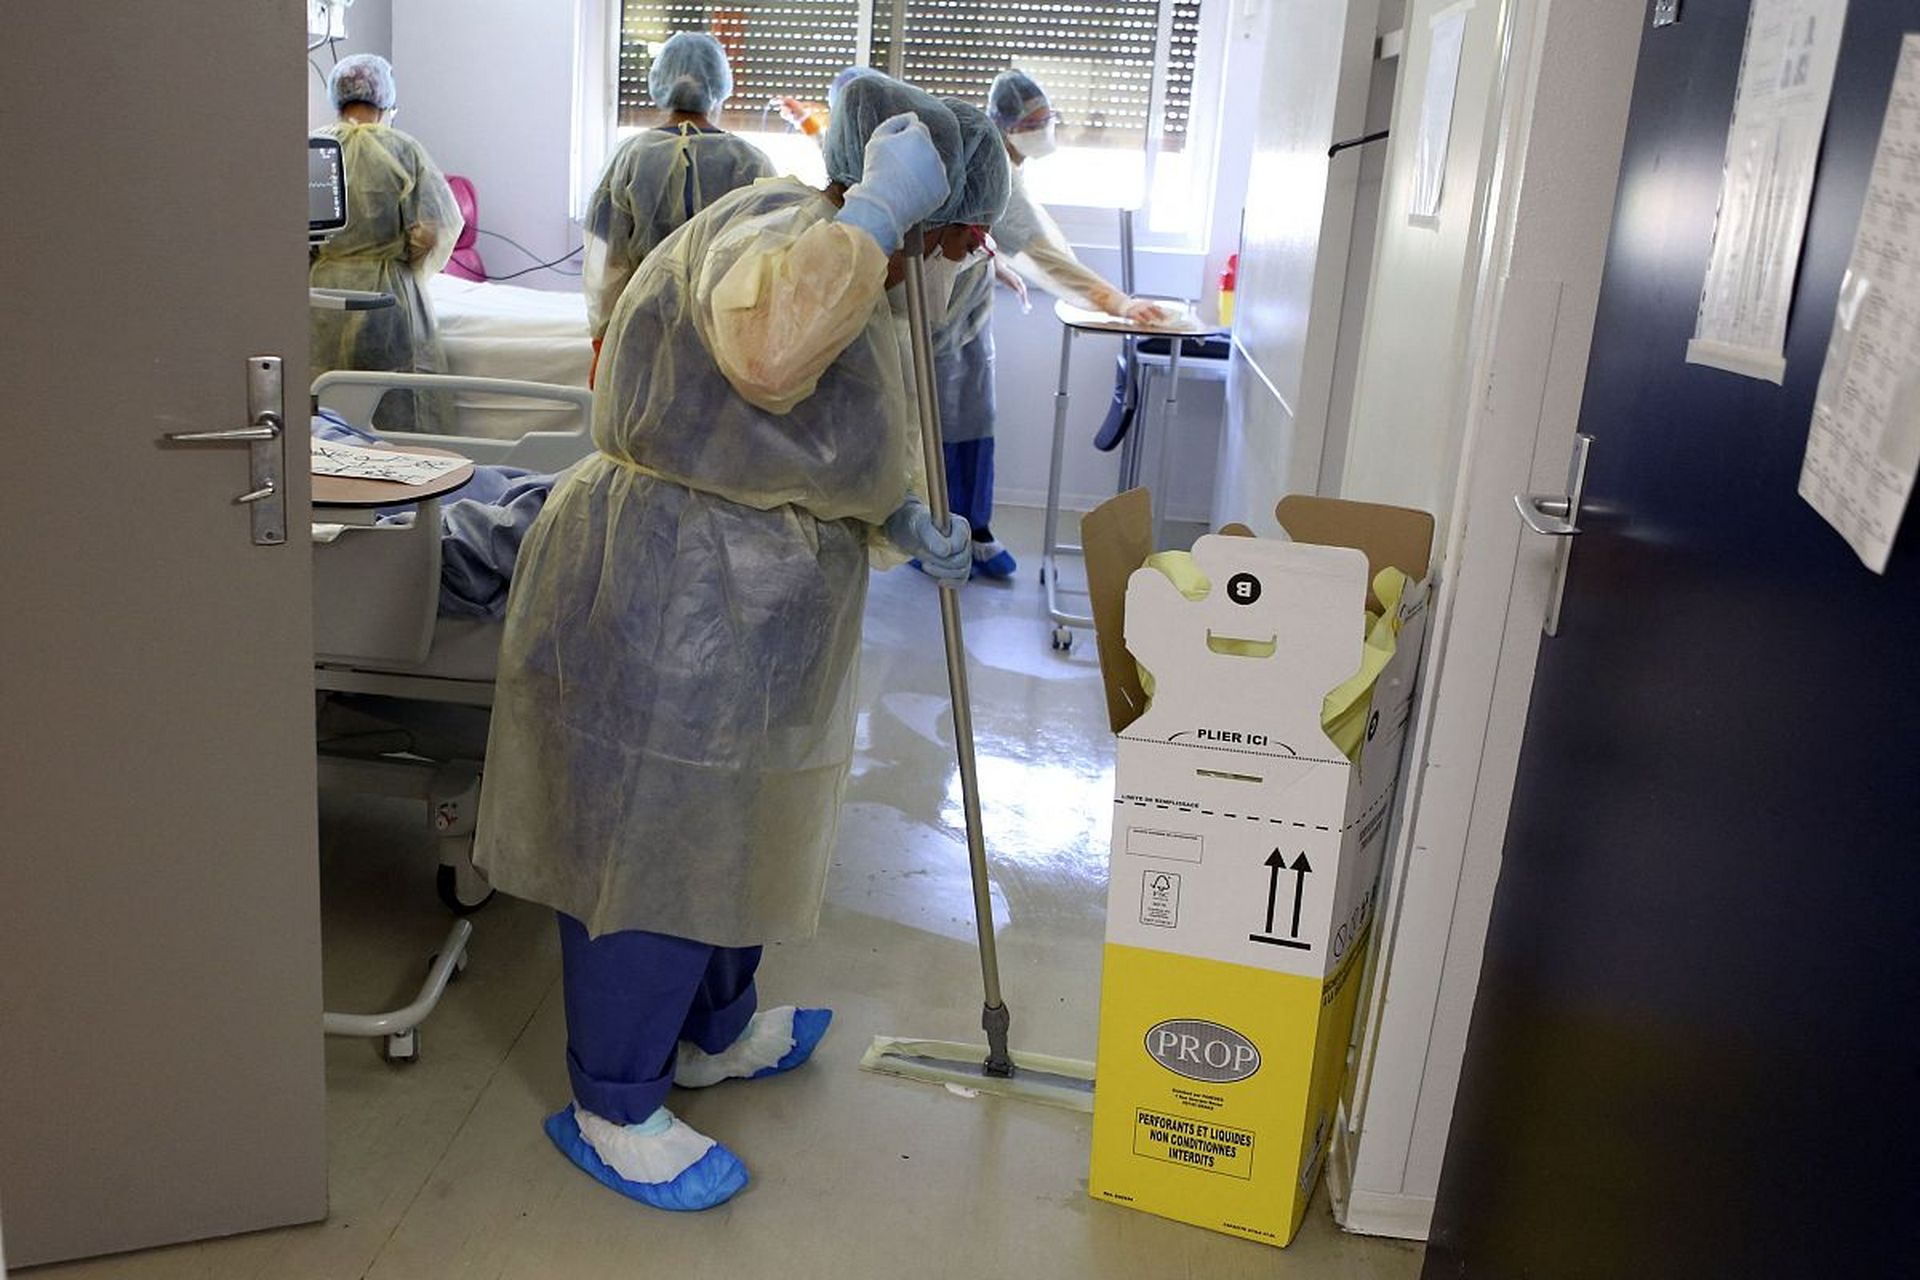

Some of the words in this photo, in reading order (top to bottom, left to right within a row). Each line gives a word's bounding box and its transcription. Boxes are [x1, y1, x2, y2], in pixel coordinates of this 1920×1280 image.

[1236, 581, 1252, 598] B
[1197, 729, 1242, 744] PLIER
[1246, 734, 1268, 746] ICI
[1157, 1030, 1255, 1071] PROP
[1138, 1112, 1195, 1135] PERFORANTS
[1197, 1125, 1209, 1137] ET
[1210, 1128, 1252, 1147] LIQUIDES
[1150, 1129, 1169, 1144] NON
[1170, 1134, 1236, 1158] CONDITIONNES
[1168, 1147, 1215, 1168] INTERDITS
